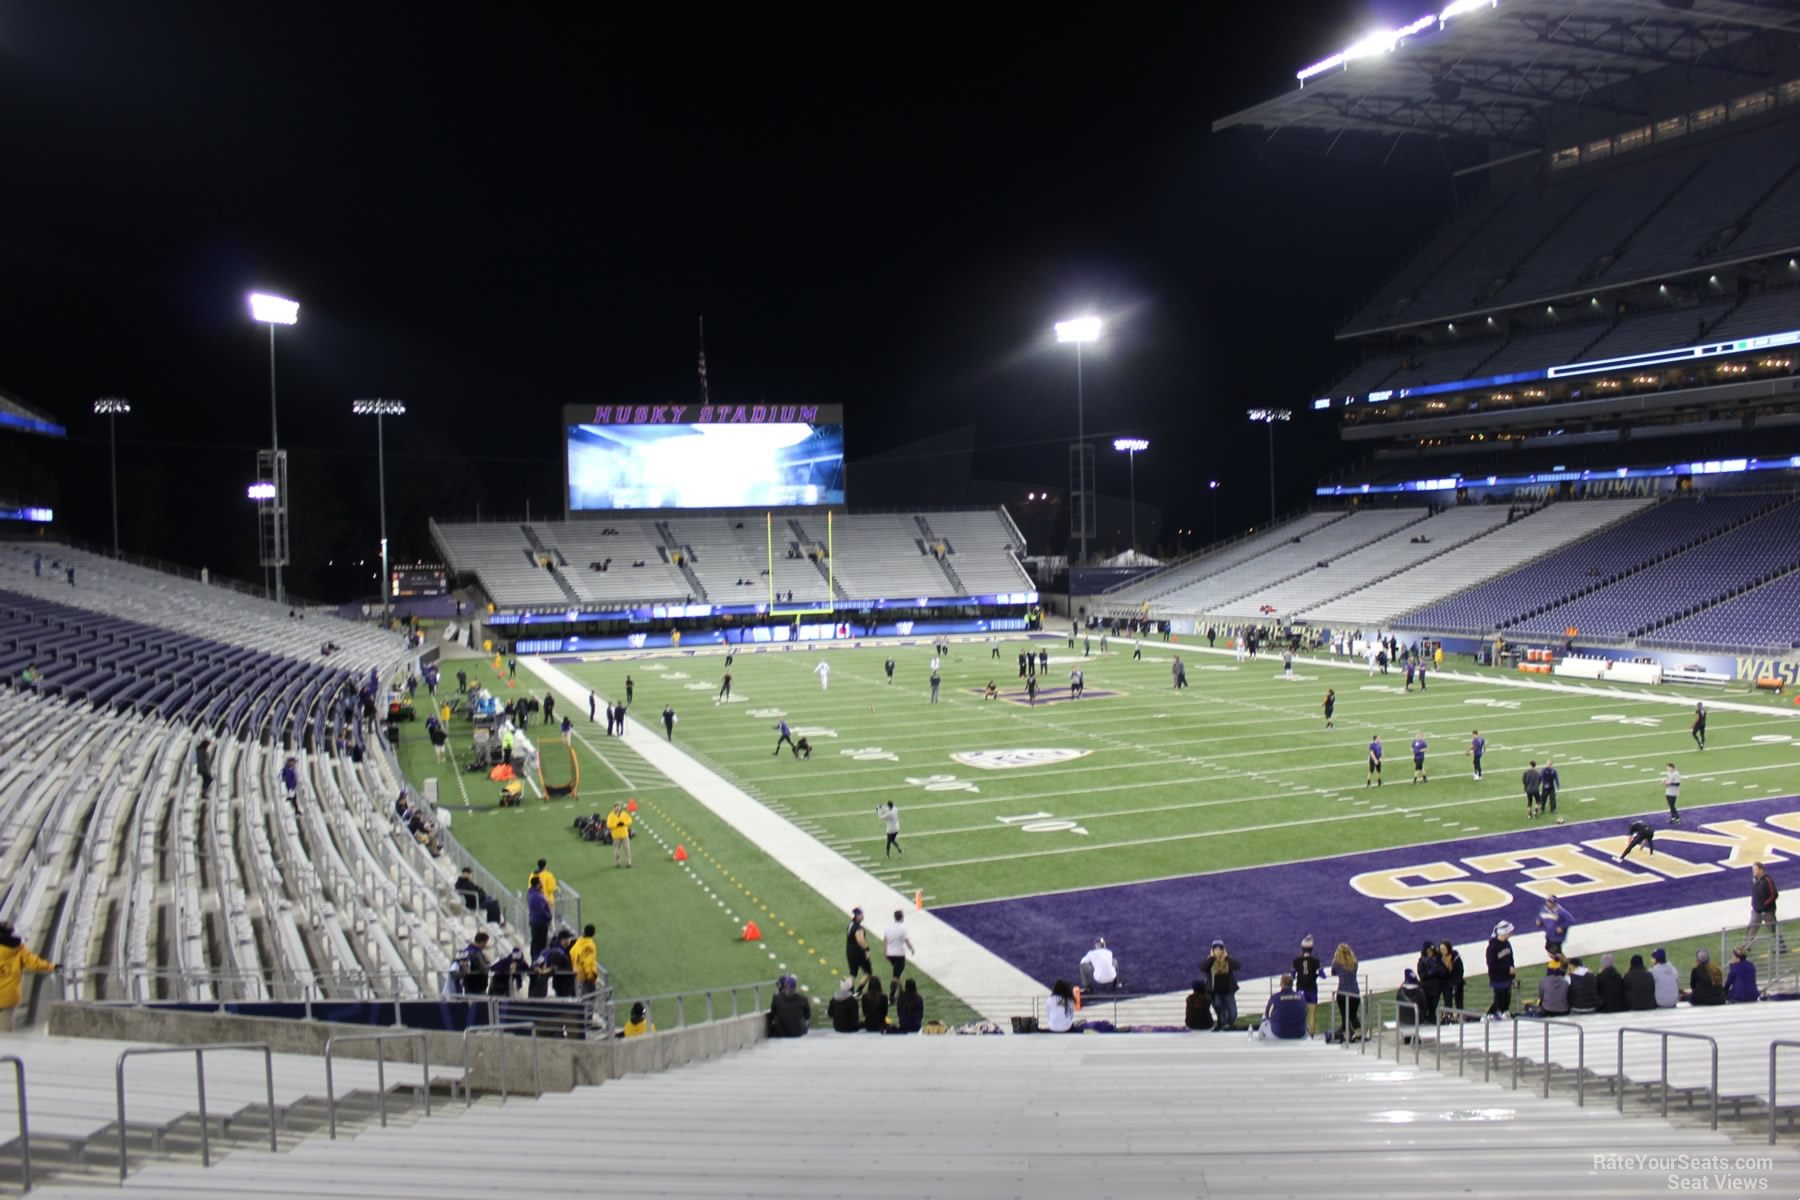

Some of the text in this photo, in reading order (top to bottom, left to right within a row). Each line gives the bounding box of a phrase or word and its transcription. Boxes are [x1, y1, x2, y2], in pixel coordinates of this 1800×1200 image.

[594, 404, 819, 424] HUSKY STADIUM
[1736, 656, 1800, 686] WAS
[995, 811, 1077, 832] 10
